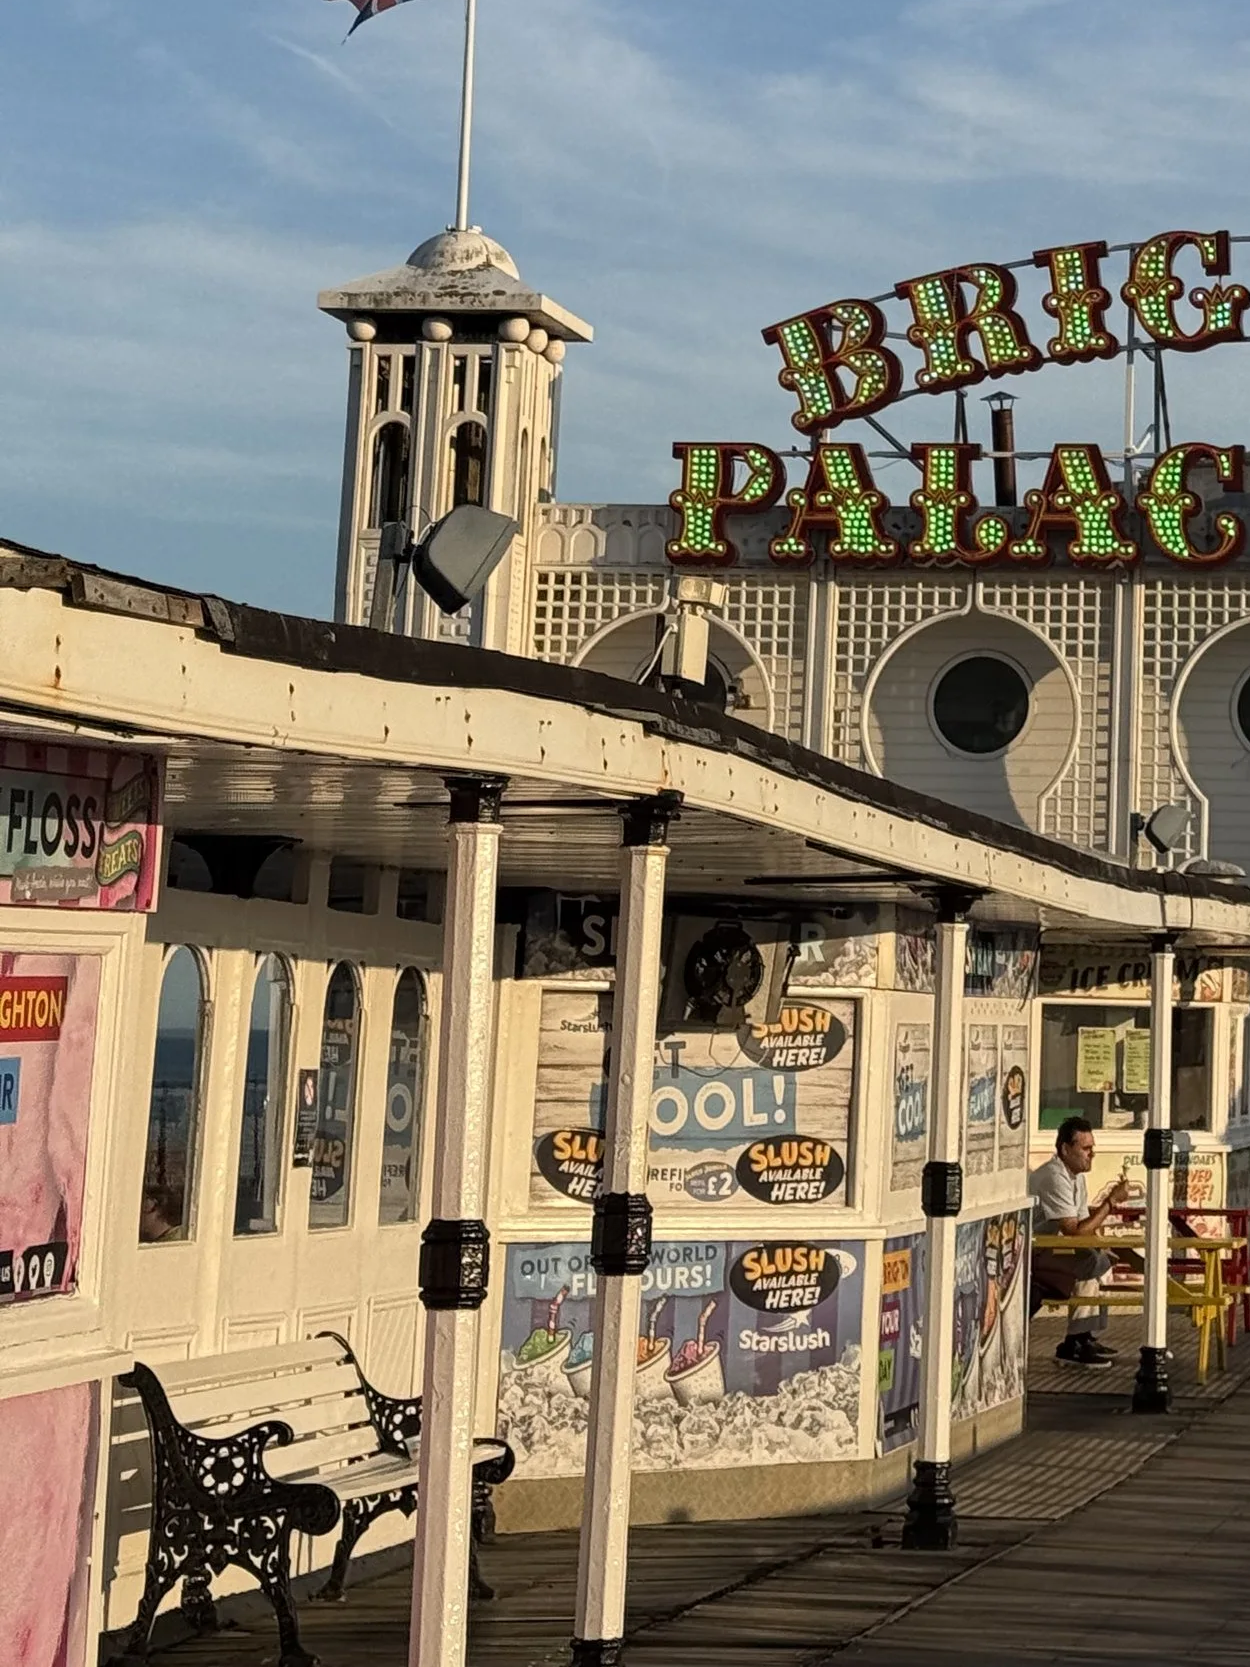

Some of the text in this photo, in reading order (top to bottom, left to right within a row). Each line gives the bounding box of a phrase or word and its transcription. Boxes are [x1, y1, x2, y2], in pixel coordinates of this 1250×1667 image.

[7, 788, 97, 860] FLOSS
[759, 1033, 824, 1050] AVAILABLE
[771, 1047, 826, 1068] HERE!
[649, 1075, 786, 1136] OOL!
[750, 1142, 831, 1173] SLUSH
[706, 1171, 734, 1197] £2
[758, 1167, 824, 1183] AVAILABLE
[769, 1181, 825, 1202] HERE!
[520, 1256, 560, 1277] OUT
[651, 1244, 718, 1264] WORLD
[742, 1247, 826, 1281] SLUSH
[572, 1264, 712, 1297] FLOURS!
[751, 1272, 819, 1292] AVAILABLE
[764, 1285, 822, 1310] HERE!
[738, 1327, 830, 1352] Starslush
